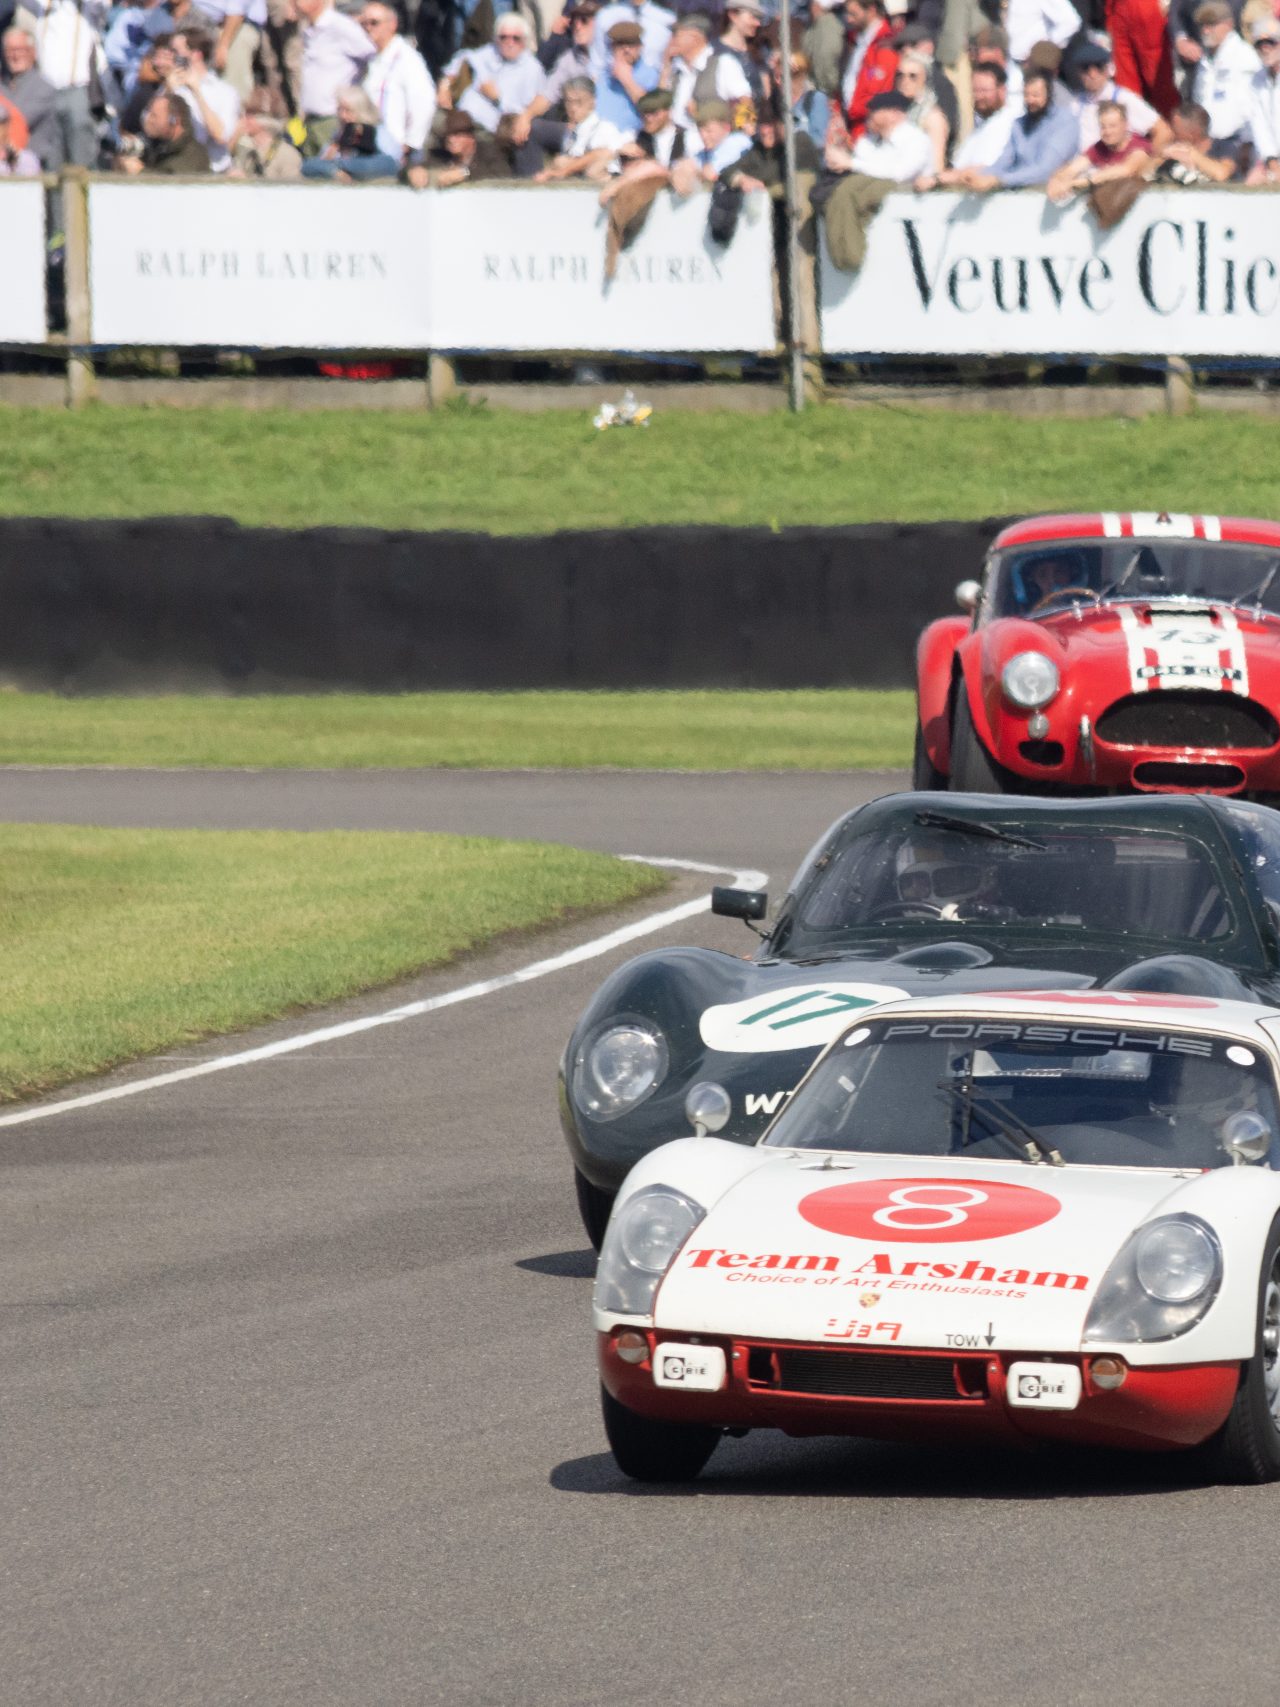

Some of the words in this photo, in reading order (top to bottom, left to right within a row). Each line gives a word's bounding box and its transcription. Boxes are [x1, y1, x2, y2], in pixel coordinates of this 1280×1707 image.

[136, 251, 239, 278] RALPH
[256, 251, 387, 279] LAUREN
[483, 254, 588, 281] RALPH
[608, 254, 725, 282] AUREN
[901, 219, 1112, 312] Veuve
[737, 990, 880, 1031] 17
[883, 1024, 1213, 1058] PORSCHE
[872, 1185, 989, 1230] 8
[687, 1248, 841, 1272] Team
[852, 1253, 1090, 1291] Arsham
[725, 1272, 807, 1285] Choice
[814, 1275, 842, 1286] of
[843, 1277, 883, 1289] Art
[887, 1279, 1028, 1300] Enthusiasts
[944, 1333, 980, 1347] TOW
